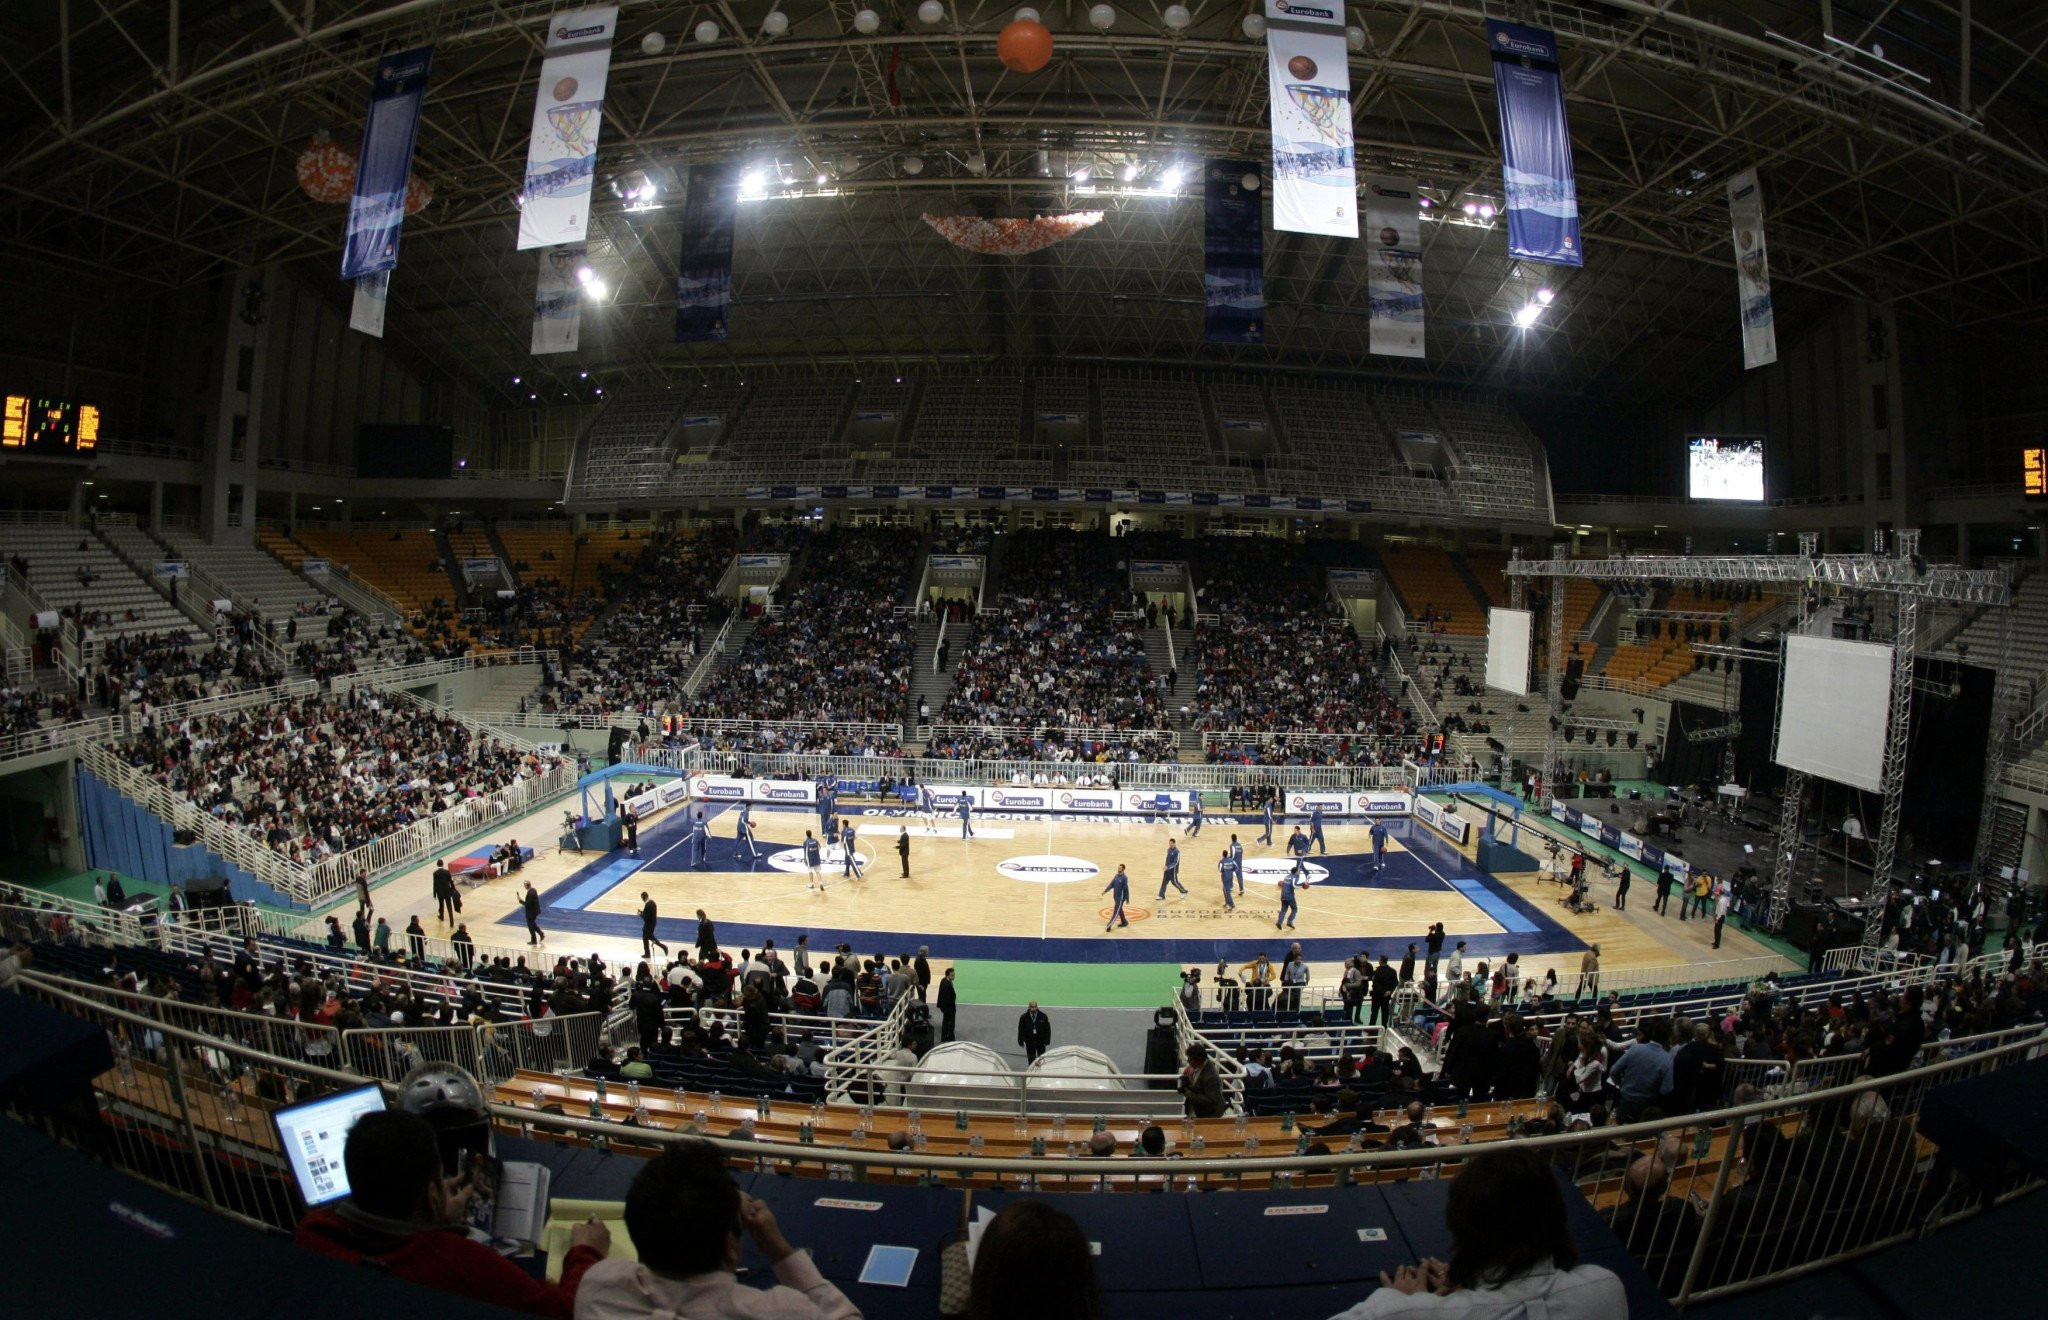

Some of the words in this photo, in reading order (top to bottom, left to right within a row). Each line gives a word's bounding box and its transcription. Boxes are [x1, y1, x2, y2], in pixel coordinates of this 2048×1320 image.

[1290, 6, 1330, 18] Eurobank
[566, 28, 601, 39] Eurobank
[1509, 41, 1546, 54] Eurobank
[667, 789, 684, 803] Eurobank
[708, 787, 742, 796] Eurobank
[771, 790, 805, 798] Eurobank
[1005, 797, 1041, 806] Eurobank
[1073, 800, 1110, 808] Eurobank
[1305, 803, 1340, 811] Eurbank
[1369, 803, 1402, 811] Eurobank
[862, 808, 962, 820] OLYMIC
[968, 812, 1054, 821] SPORTS
[1059, 815, 1147, 824] CENTER
